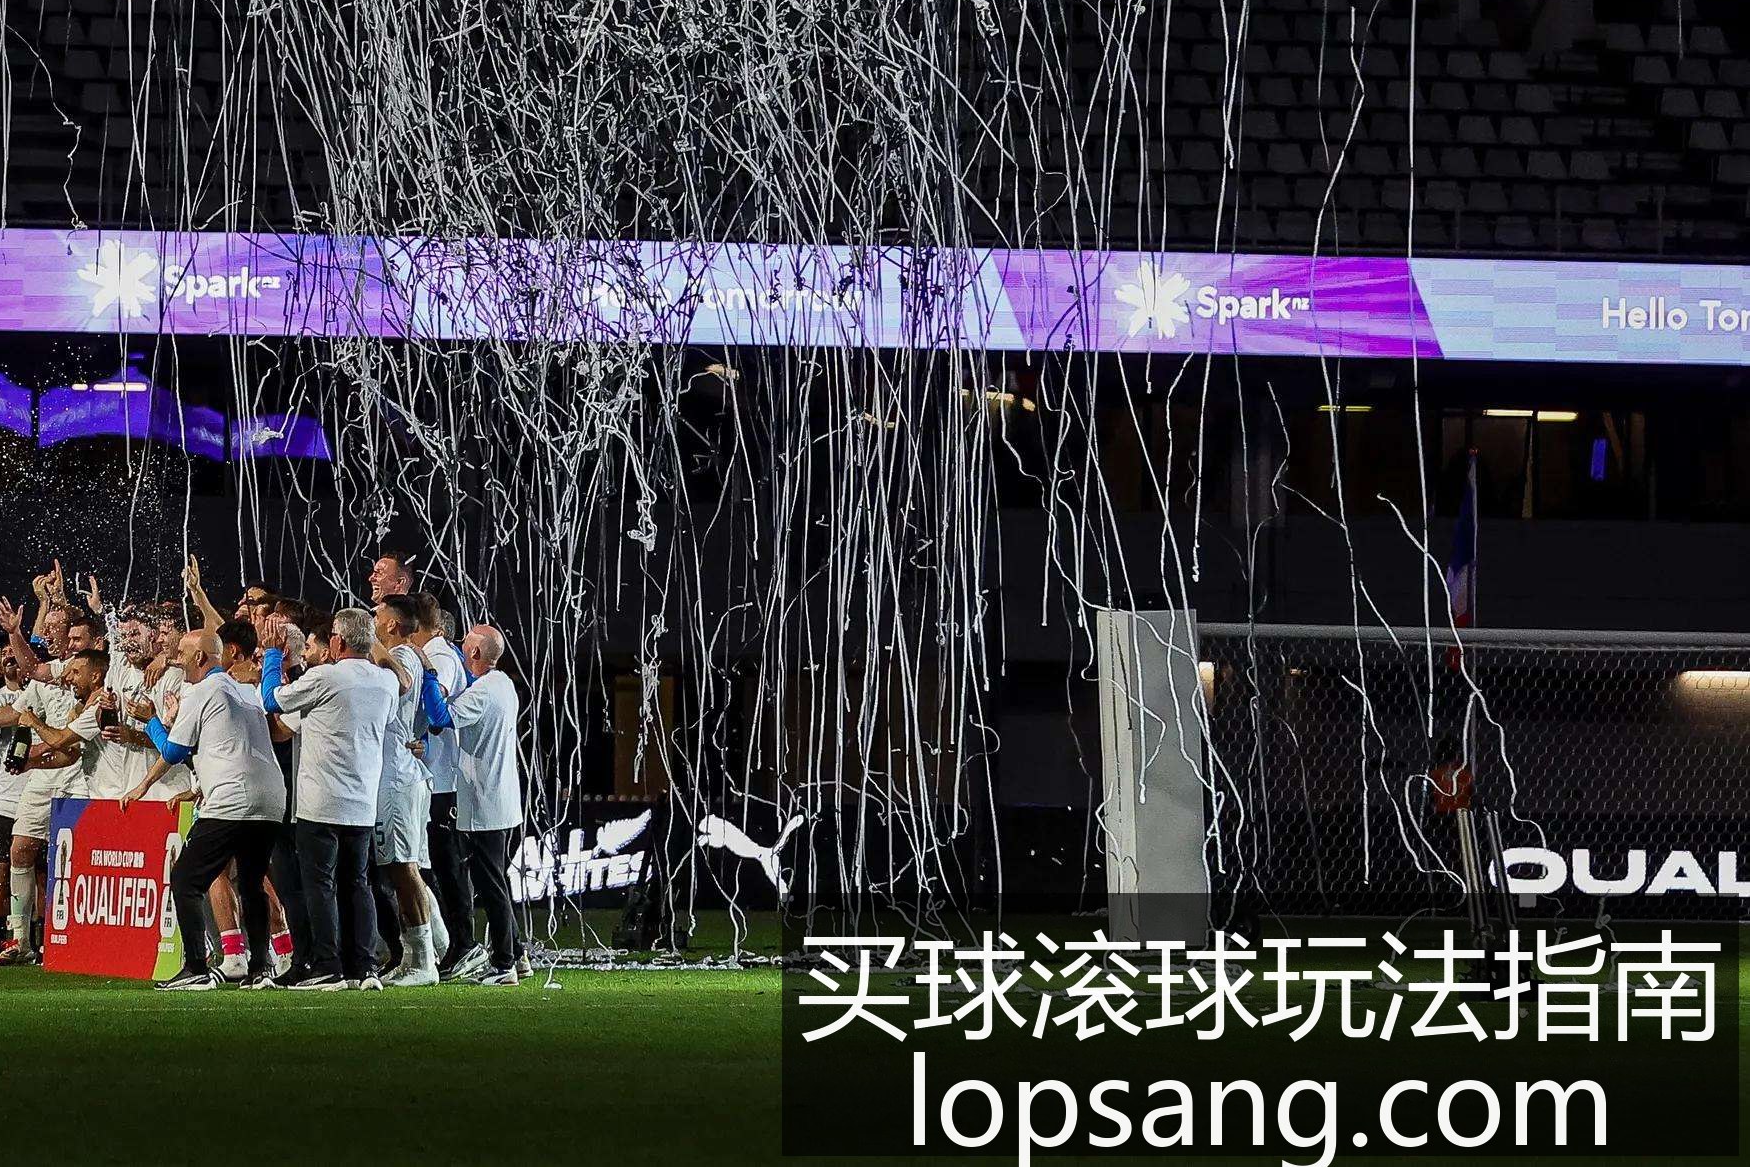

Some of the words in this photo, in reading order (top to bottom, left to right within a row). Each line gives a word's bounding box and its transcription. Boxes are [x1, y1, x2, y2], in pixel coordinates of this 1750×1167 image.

[163, 264, 261, 305] Spark
[1196, 285, 1291, 325] Spark
[1602, 296, 1688, 330] Hello
[1488, 847, 1750, 907] QUAL
[74, 874, 158, 928] QUALIFIED
